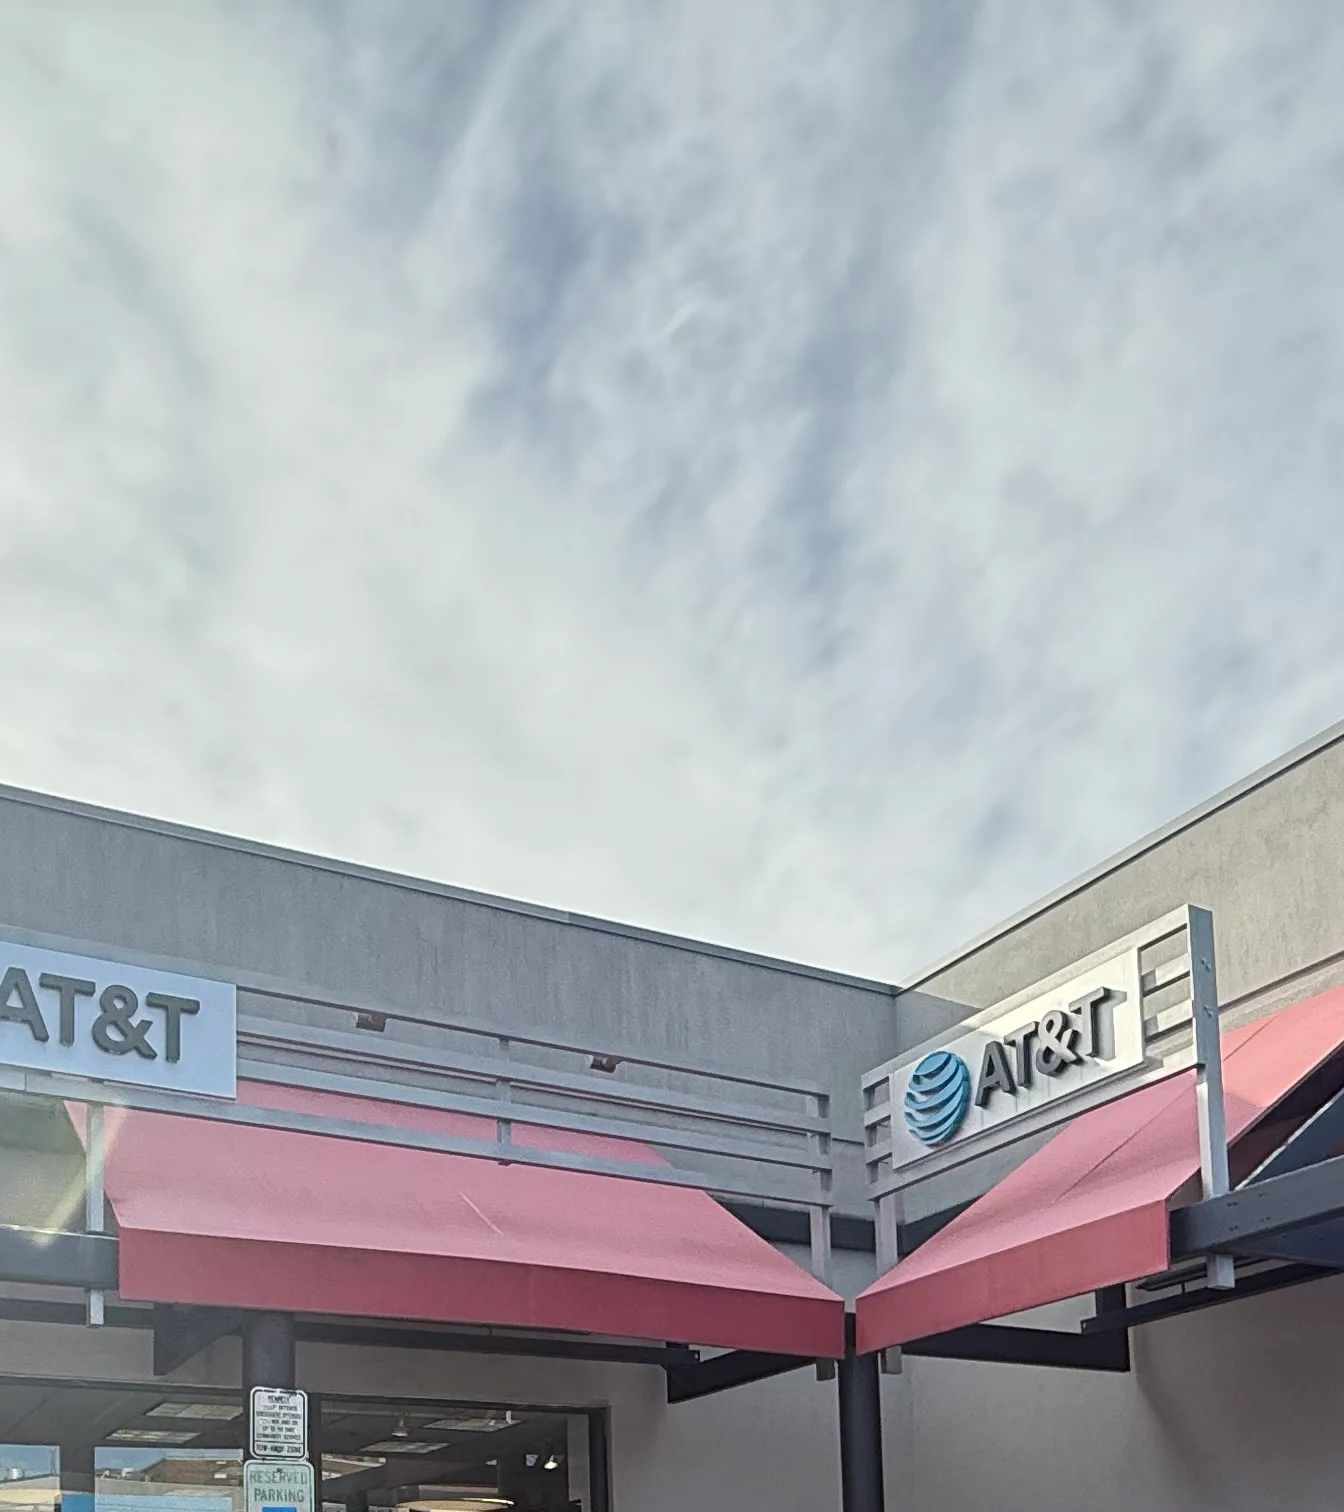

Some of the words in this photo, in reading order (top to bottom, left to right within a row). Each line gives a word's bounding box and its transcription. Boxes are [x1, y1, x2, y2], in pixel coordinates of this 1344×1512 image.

[974, 986, 1113, 1107] AT&T
[249, 1470, 308, 1485] RESERVED
[254, 1487, 305, 1503] PARKING
